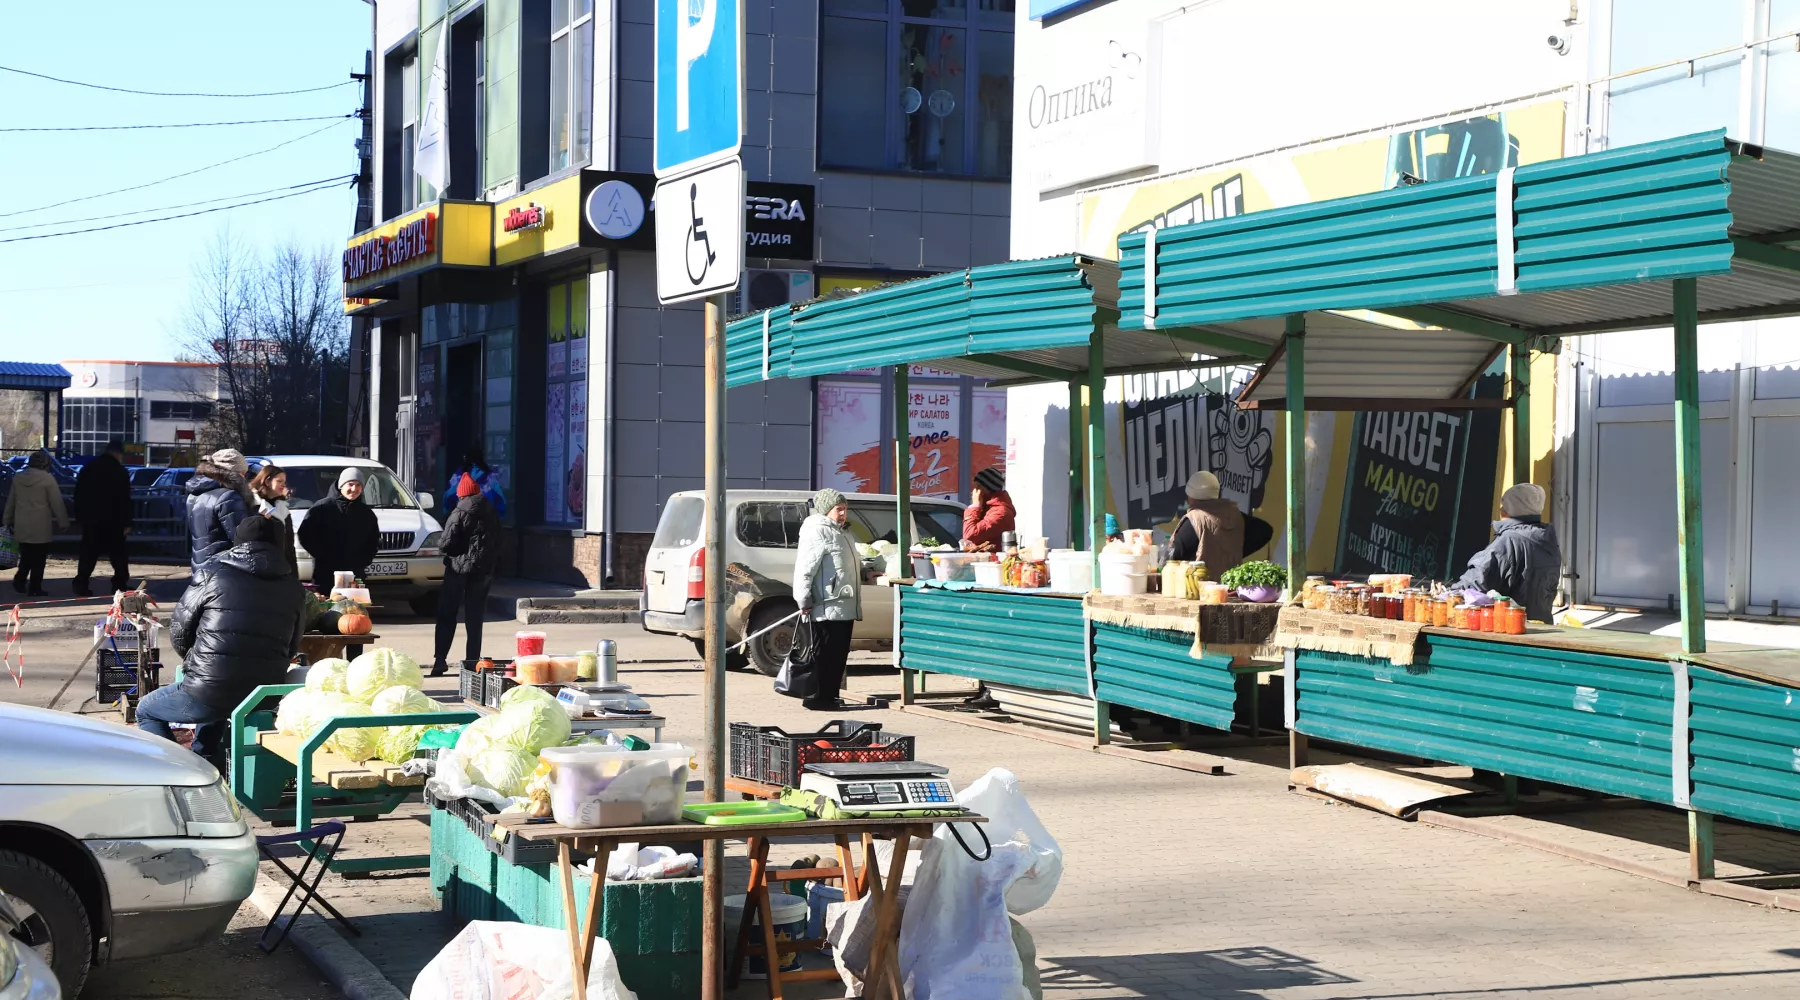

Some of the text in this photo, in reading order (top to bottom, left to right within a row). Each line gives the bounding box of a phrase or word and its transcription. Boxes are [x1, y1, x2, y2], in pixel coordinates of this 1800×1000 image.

[1028, 75, 1113, 129] Оптика
[746, 231, 792, 246] тудия
[909, 409, 950, 420] ИР САЛАТОВ
[917, 421, 935, 429] KOREA
[1126, 395, 1211, 510] ЦЕЛИ
[1223, 469, 1252, 494] TARGET
[1364, 459, 1440, 512] MANGO
[1348, 532, 1412, 574] СТАВЯТ ЦЕЛИ
[1370, 522, 1414, 557] КРУТЫЕ
[395, 562, 404, 570] 22
